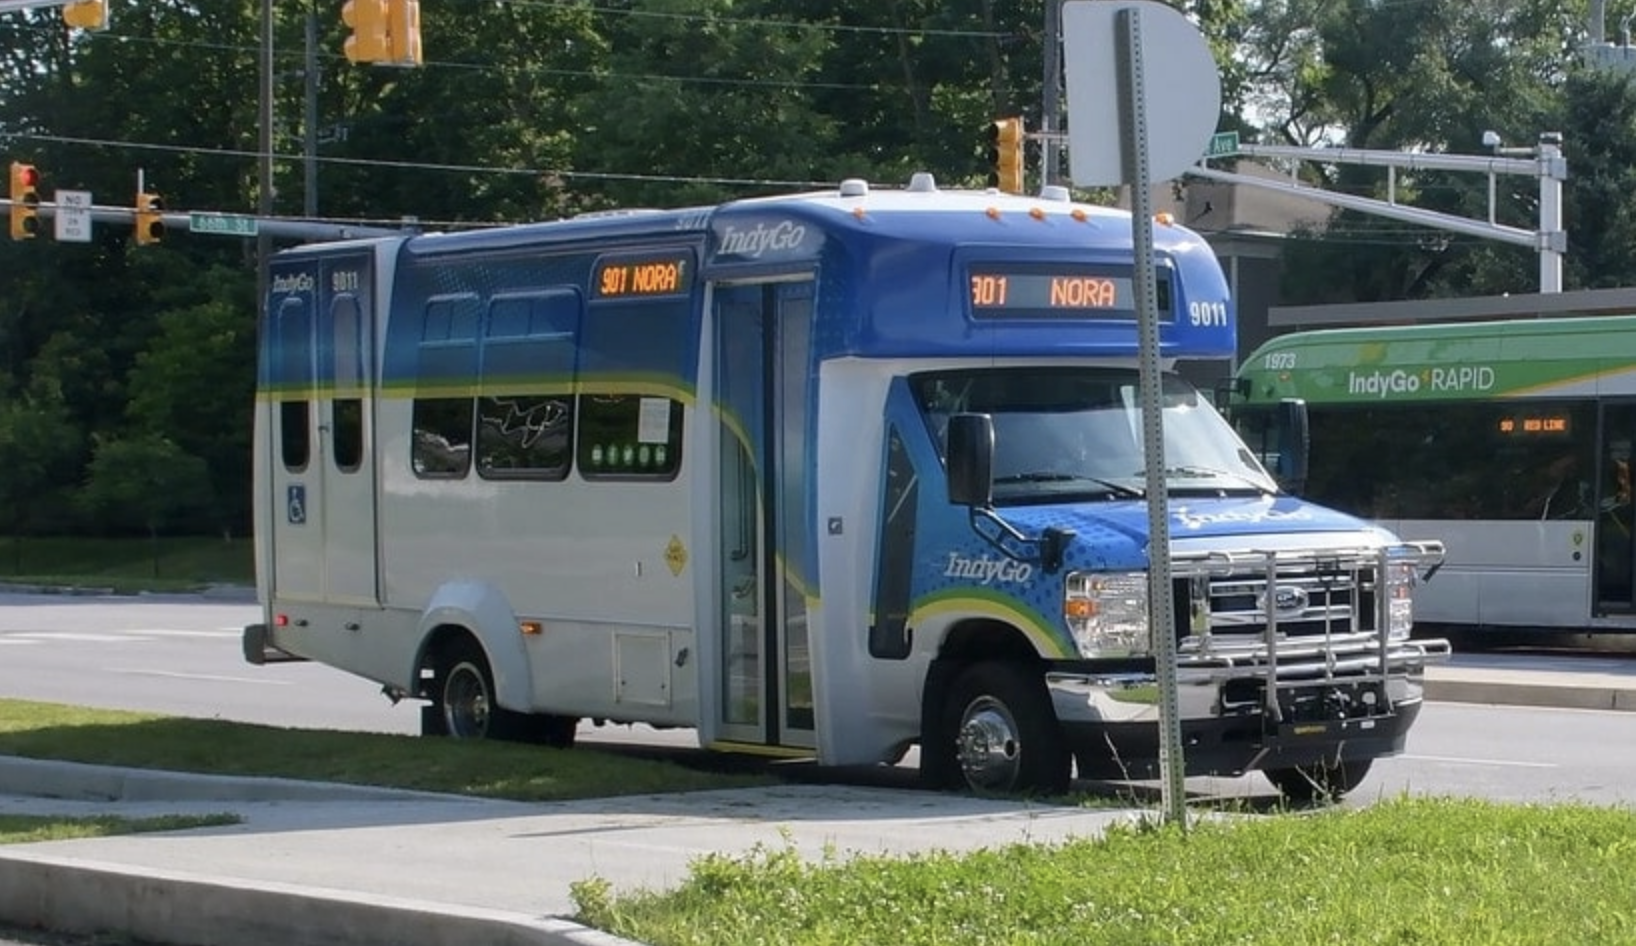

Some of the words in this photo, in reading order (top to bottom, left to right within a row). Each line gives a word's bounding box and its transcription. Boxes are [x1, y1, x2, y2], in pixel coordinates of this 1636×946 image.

[1213, 136, 1233, 154] Ave
[717, 220, 805, 258] IndyGo
[272, 272, 315, 296] IndyGo
[332, 271, 359, 292] 9011
[601, 266, 627, 294] 901
[632, 263, 677, 292] NORA
[1051, 278, 1114, 306] NORA
[1190, 302, 1227, 327] 9011
[1264, 353, 1296, 369] 1973
[1349, 370, 1419, 398] IndyGo
[1431, 367, 1494, 390] RAPID
[1543, 419, 1566, 431] LINE
[943, 551, 1032, 585] IndyGo
